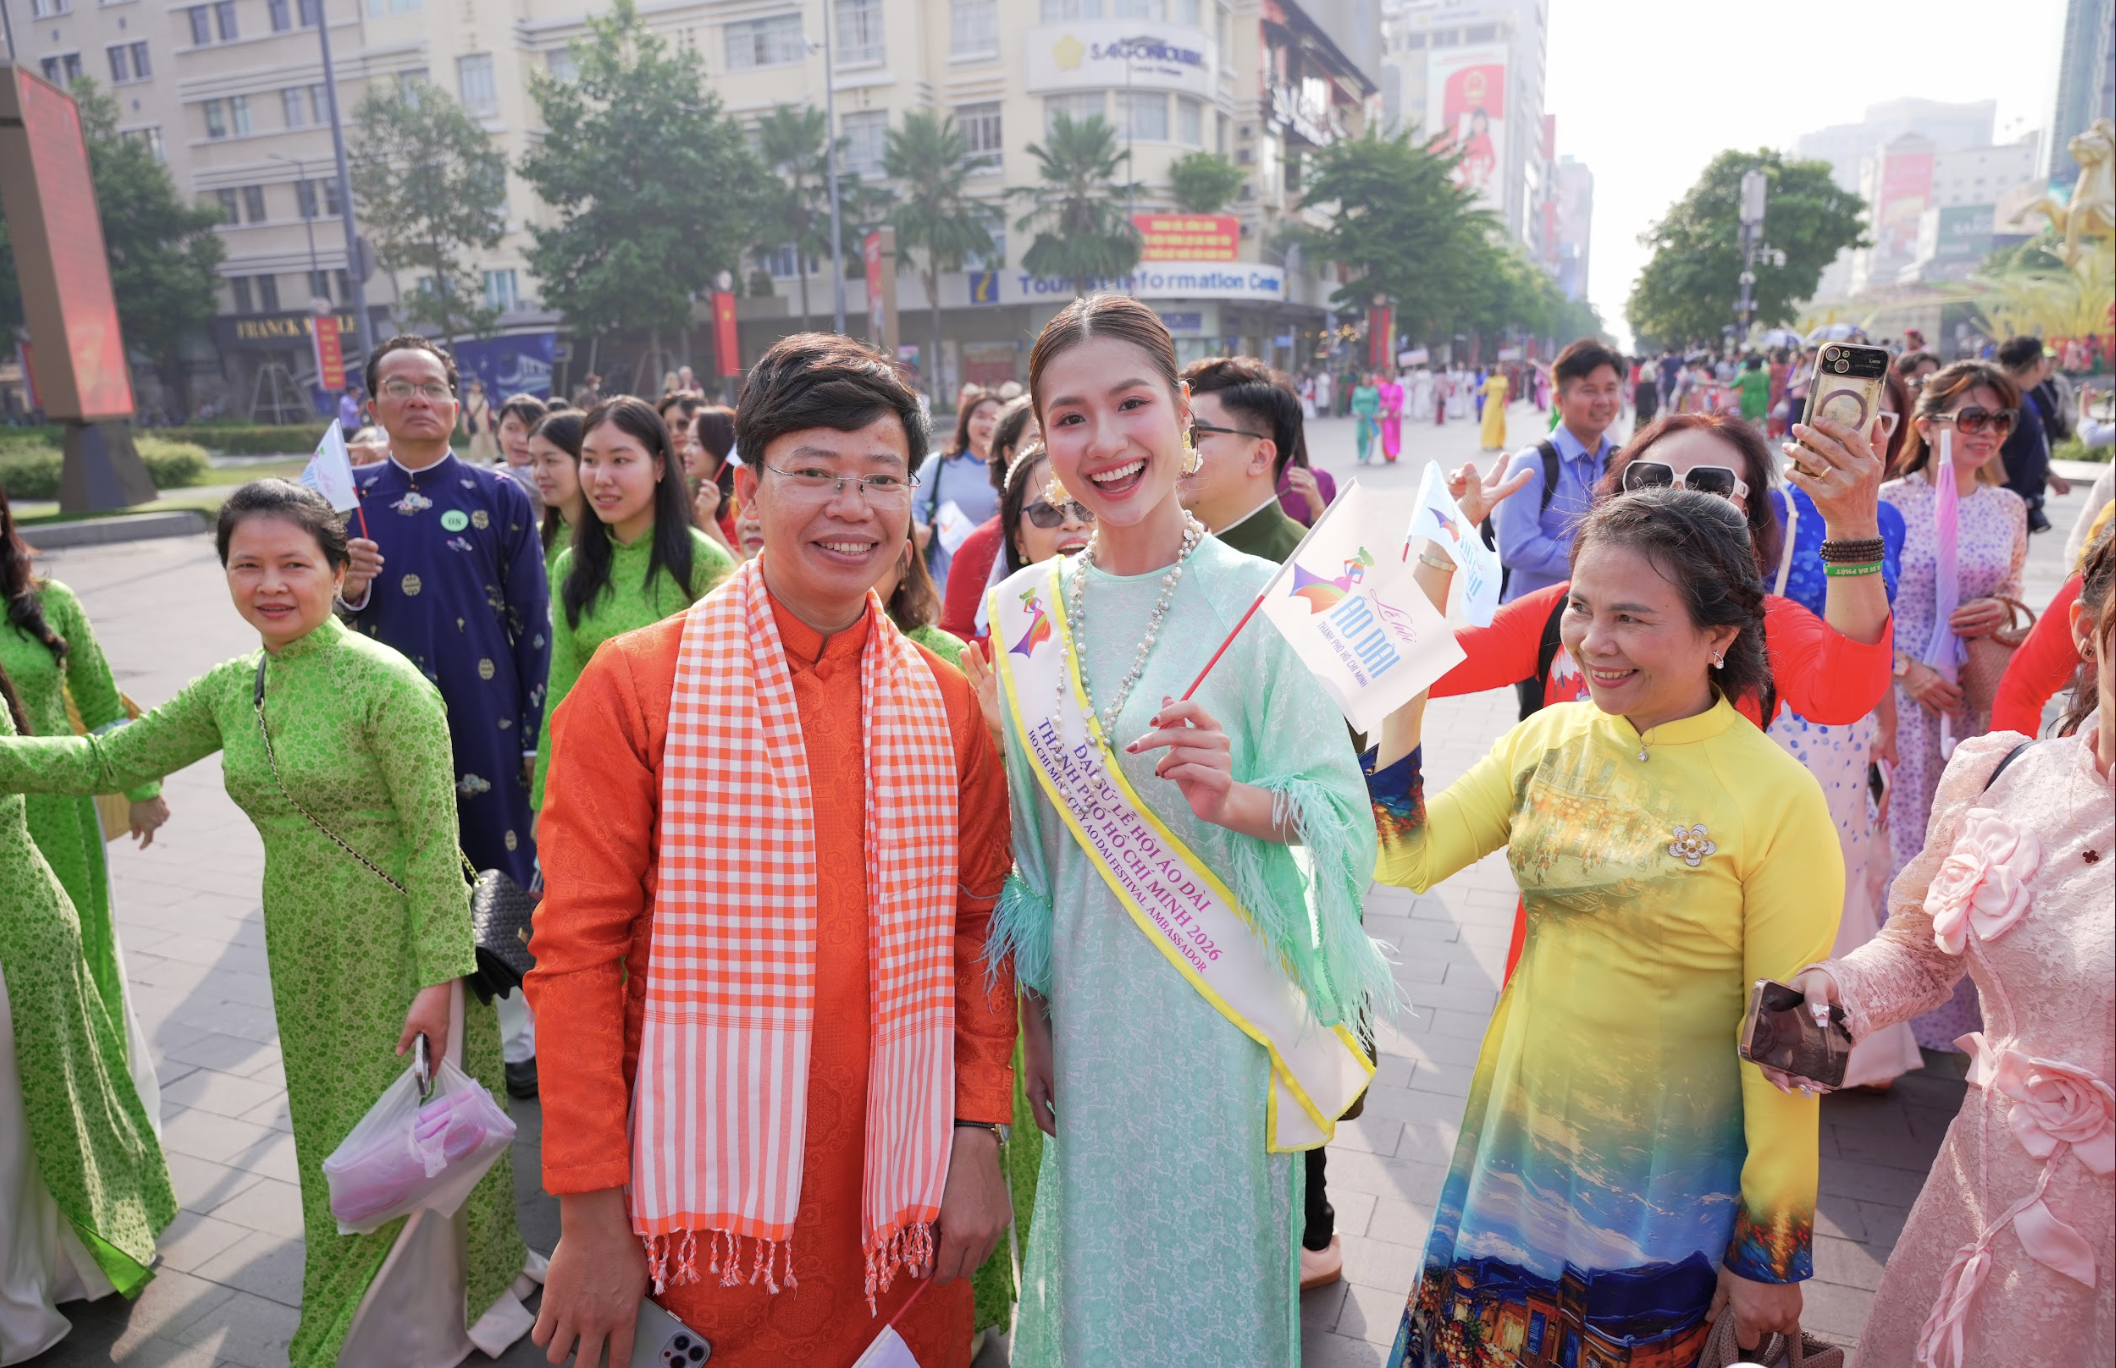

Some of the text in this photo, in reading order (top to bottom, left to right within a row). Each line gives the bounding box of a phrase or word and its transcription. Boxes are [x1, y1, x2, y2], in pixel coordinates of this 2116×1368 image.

[1018, 275, 1109, 295] Tourst
[1329, 595, 1401, 679] ÁO DÀI
[1353, 670, 1368, 687] MINH
[1028, 730, 1040, 747] HO
[1037, 749, 1052, 767] CHI
[1084, 825, 1100, 840] AO
[1095, 839, 1114, 858] DAI
[1109, 859, 1148, 906] FESTIVAL
[1146, 906, 1207, 973] AMBASSADOR
[1038, 717, 1222, 962] THÀNH PHỐ HỒ CHÍ MINH 2026
[1073, 743, 1101, 777] ĐẠI
[1111, 803, 1139, 827] LỄ
[1129, 825, 1161, 859] HỘI
[1156, 858, 1183, 883] ÁO
[1178, 881, 1212, 912] DÀI
